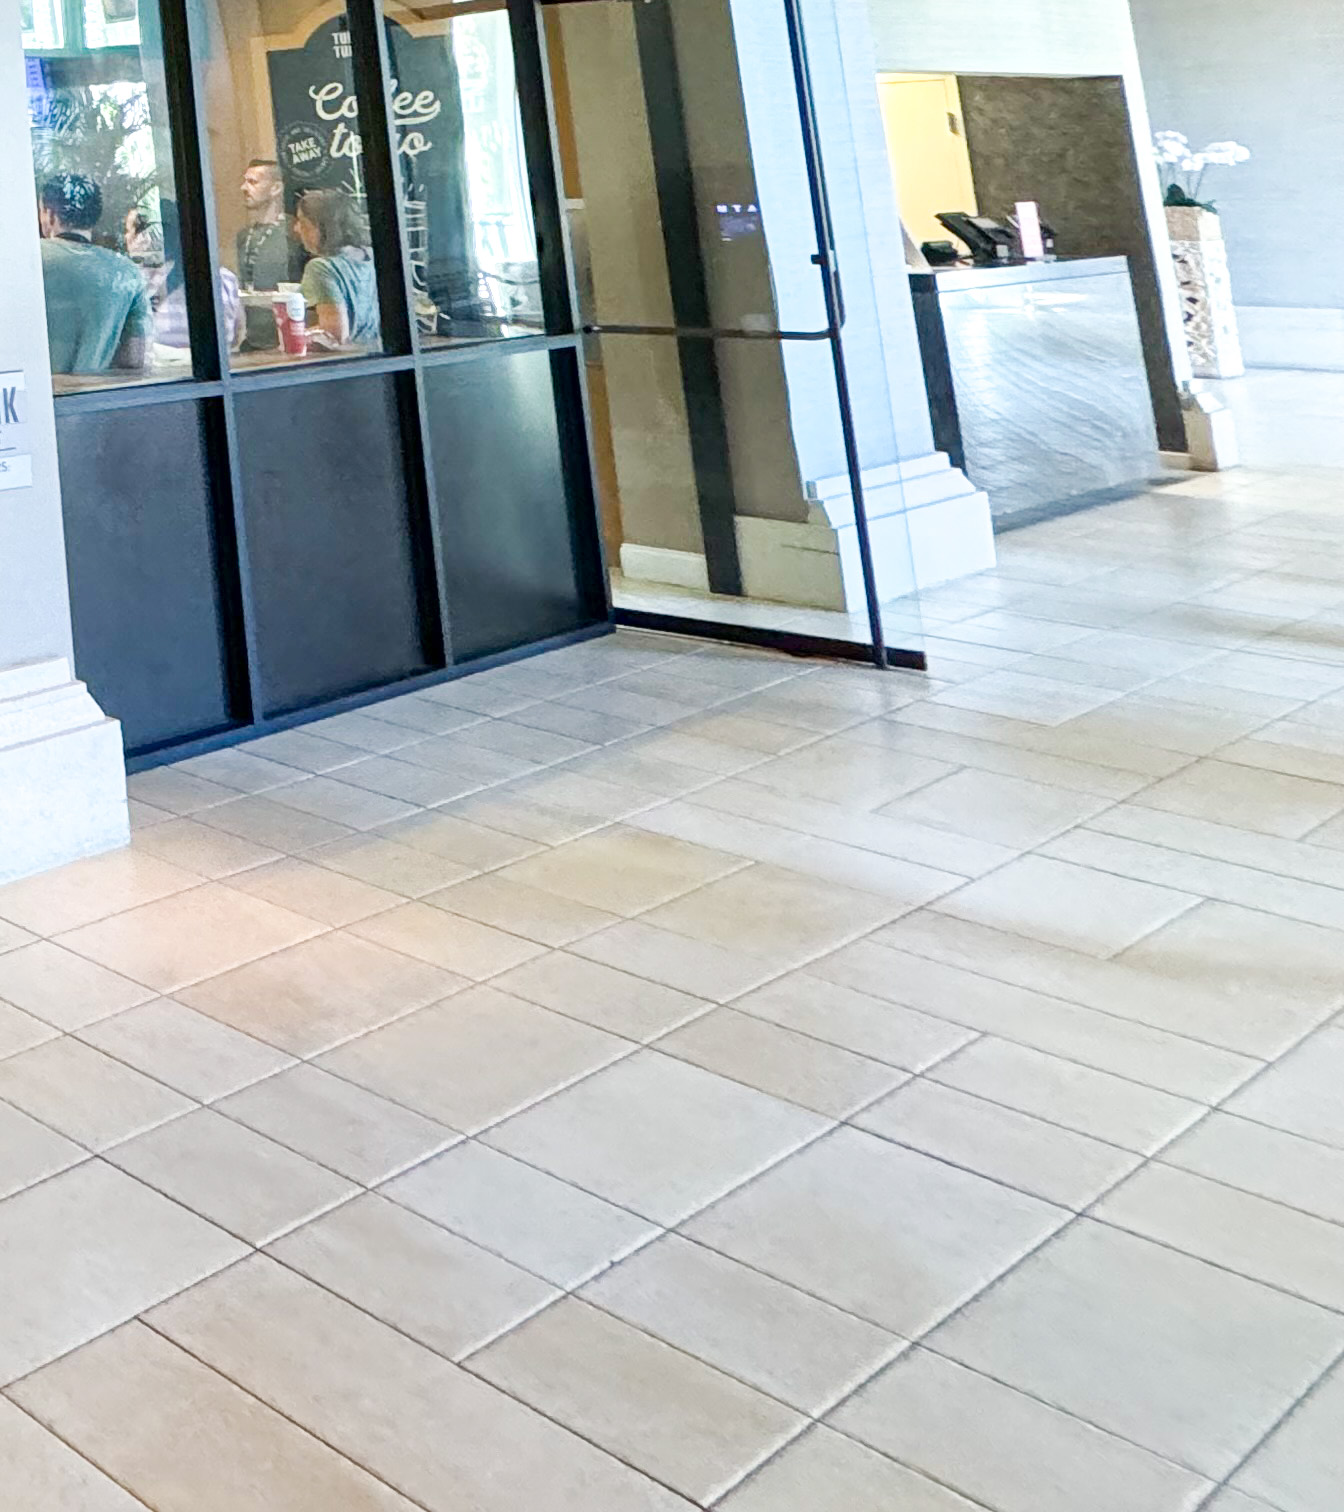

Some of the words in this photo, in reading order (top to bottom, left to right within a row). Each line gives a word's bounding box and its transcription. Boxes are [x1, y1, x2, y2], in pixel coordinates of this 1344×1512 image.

[331, 31, 351, 45] TU
[333, 45, 353, 59] TU
[308, 78, 441, 125] Coee
[288, 137, 317, 154] TAKE
[330, 122, 364, 159] to
[292, 147, 322, 165] AWAY
